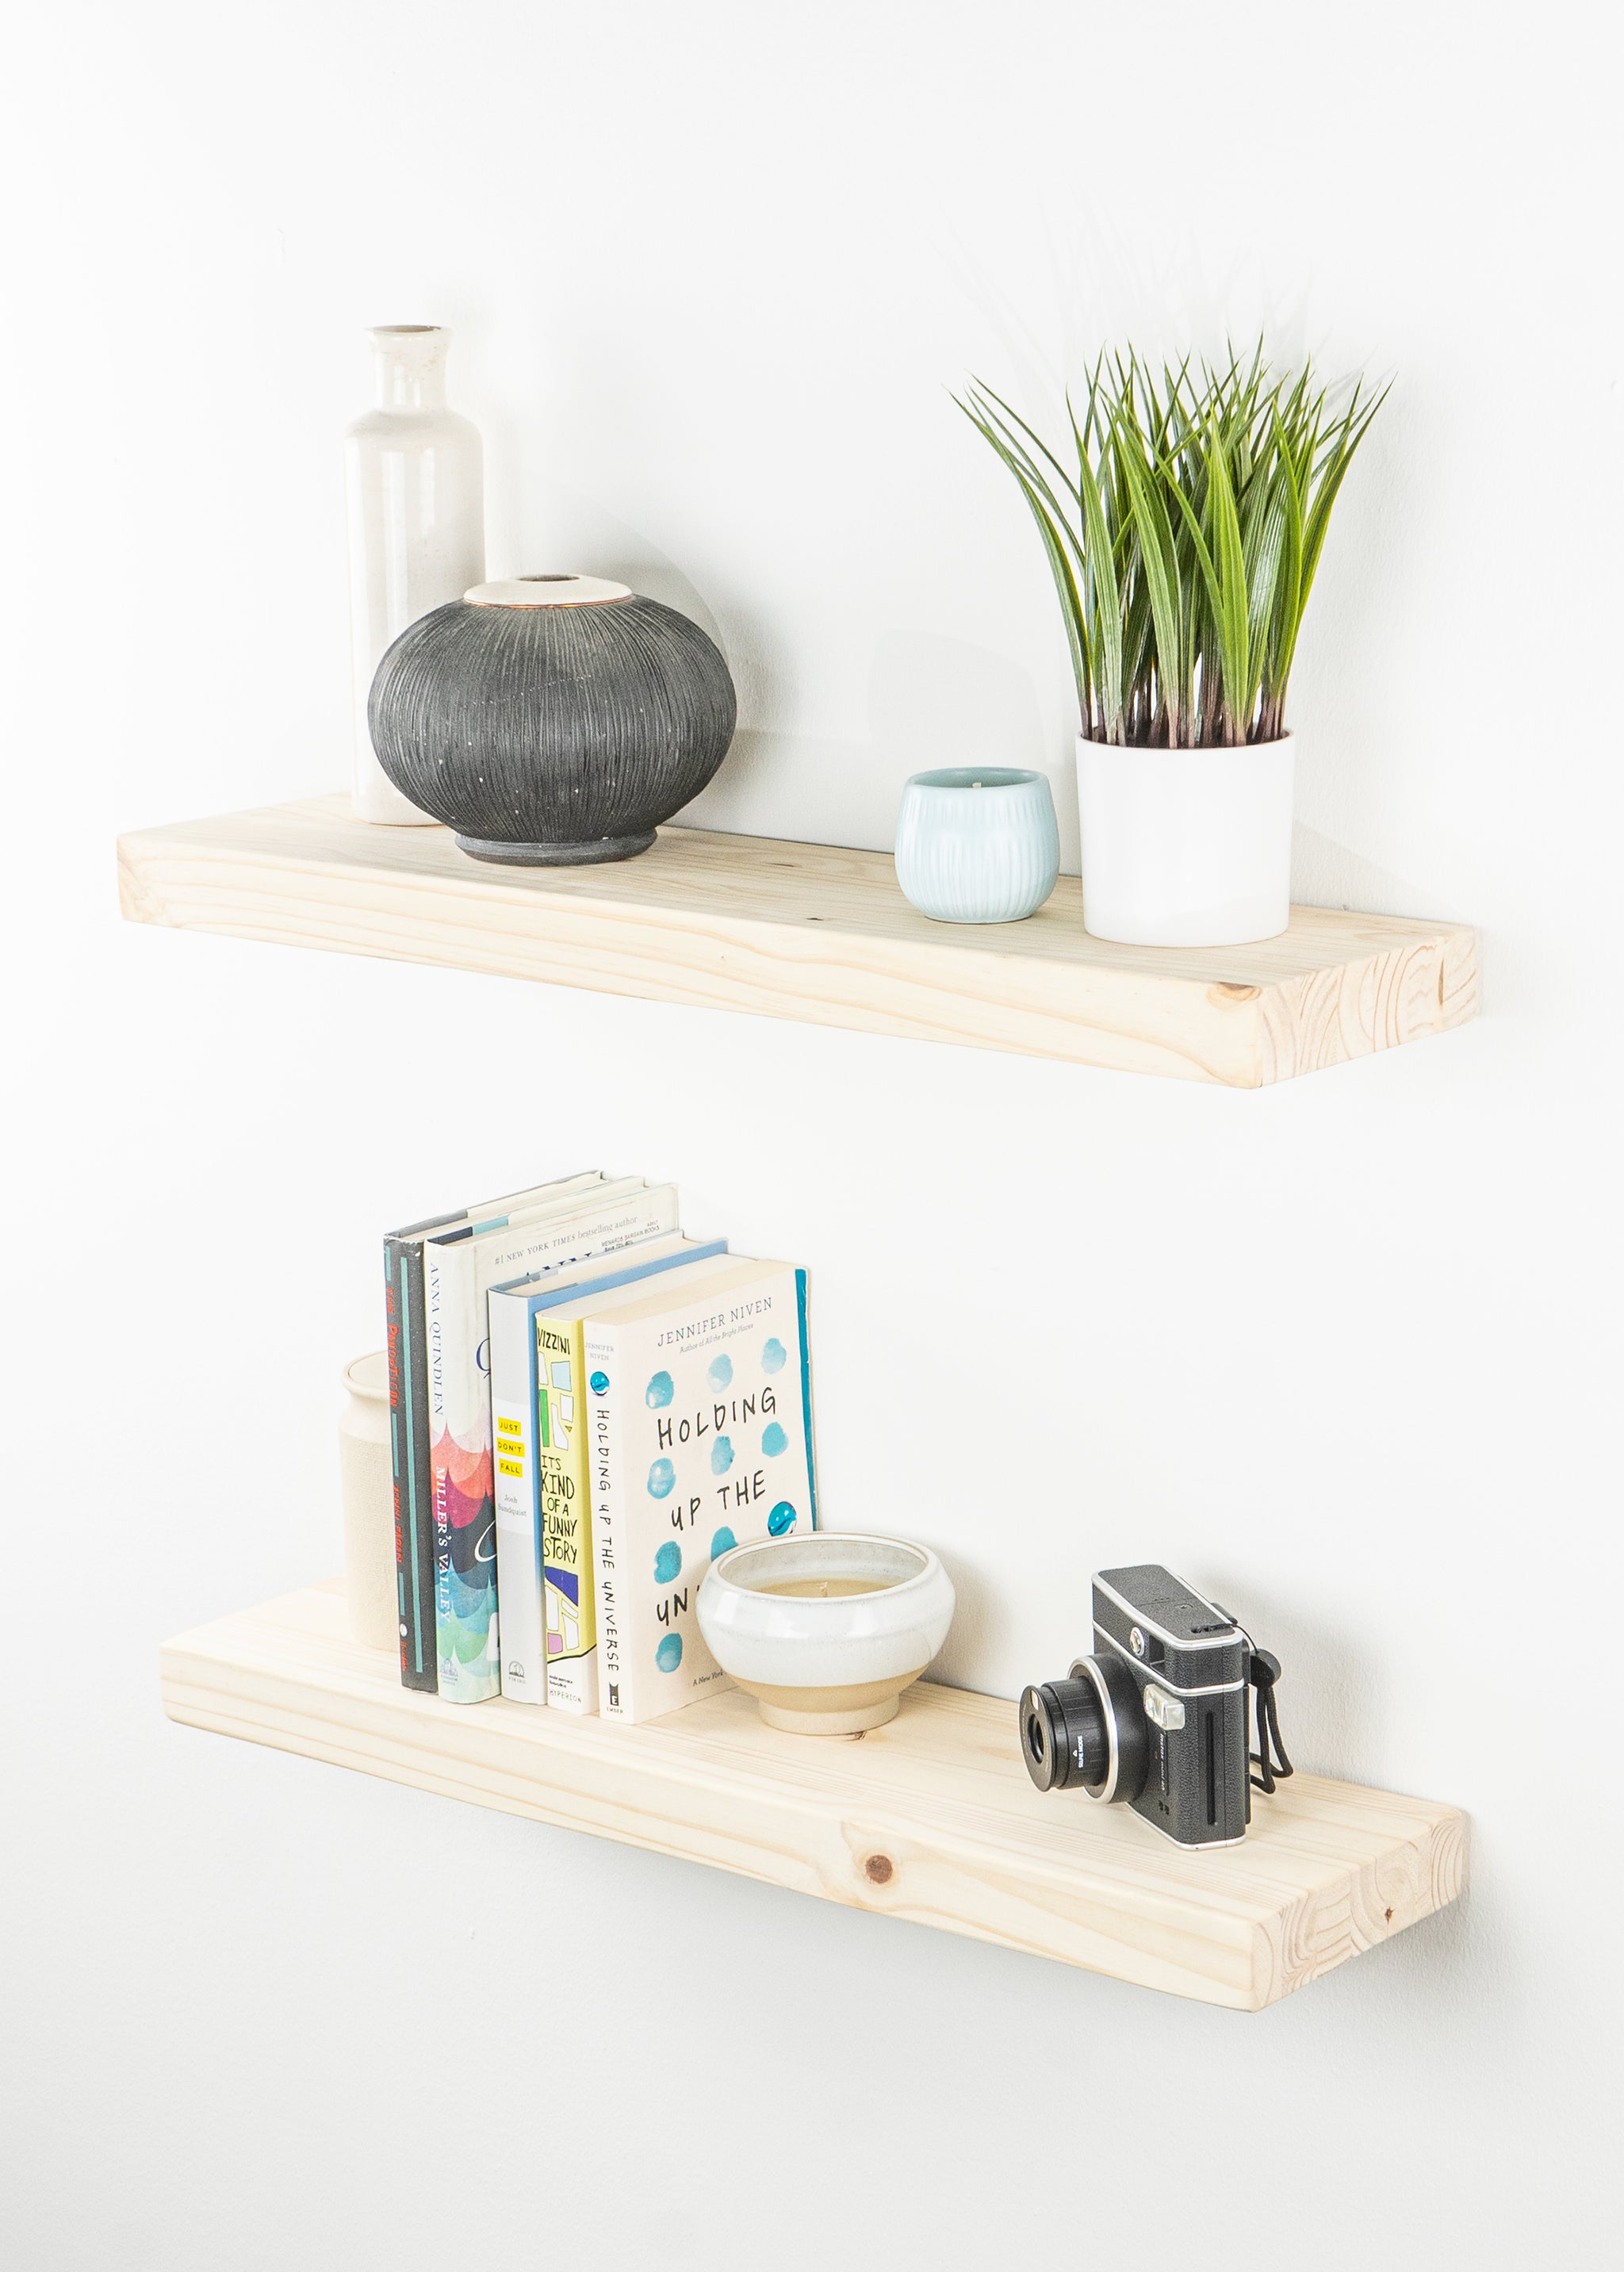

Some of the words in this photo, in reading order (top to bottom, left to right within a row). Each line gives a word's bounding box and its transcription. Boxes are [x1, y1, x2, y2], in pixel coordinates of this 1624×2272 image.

[494, 1252, 504, 1265] #1
[506, 1249, 525, 1262] NEW
[527, 1243, 549, 1256] YORK
[551, 1234, 576, 1247] TIMES
[577, 1223, 613, 1241] bestselling
[615, 1215, 638, 1228] author
[644, 1224, 661, 1235] BOOKS
[431, 1262, 439, 1313] ANNA
[657, 1313, 726, 1347] JENNIFER
[730, 1297, 773, 1323] NIVEN
[538, 1327, 570, 1355] VIZZINI
[585, 1342, 615, 1353] JENNIFER
[680, 1343, 698, 1354] Author
[722, 1328, 737, 1339] Bright
[737, 1324, 754, 1333] Places
[430, 1321, 443, 1416] QUINDLEN
[589, 1352, 610, 1362] NIVEN
[500, 1421, 518, 1432] JUST
[657, 1386, 776, 1450] HOLDING
[497, 1441, 522, 1454] DON'T
[596, 1409, 611, 1492] HOLDING
[500, 1462, 520, 1474] FALL
[541, 1469, 575, 1500] KIND
[436, 1467, 452, 1547] MILLER'S
[547, 1496, 560, 1513] OF
[562, 1503, 569, 1516] A
[672, 1496, 701, 1531] UP
[716, 1469, 766, 1510] THE
[542, 1512, 577, 1538] FUNNY
[599, 1504, 611, 1526] UP
[543, 1536, 577, 1564] STORY
[601, 1536, 615, 1569] THE
[439, 1553, 450, 1623] VALLEY
[601, 1580, 619, 1672] UNIVERSE
[698, 1676, 710, 1684] New
[549, 1689, 583, 1703] HYPERION
